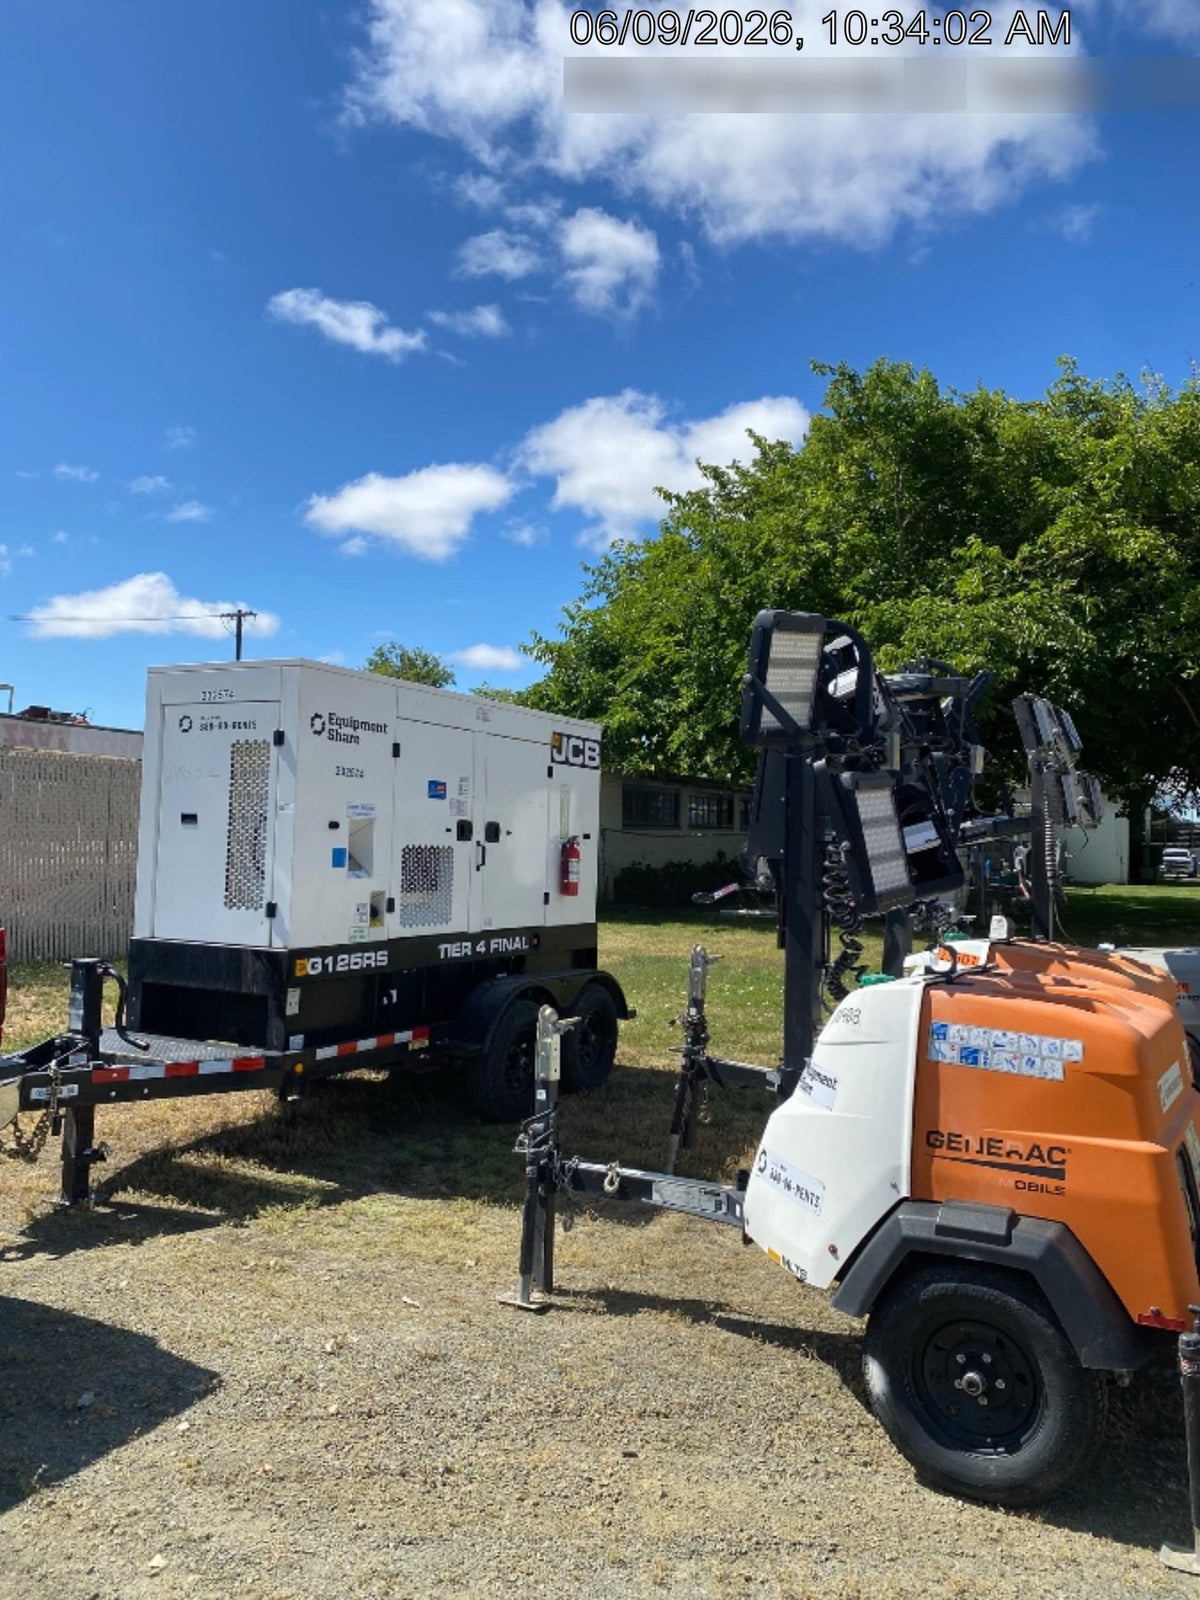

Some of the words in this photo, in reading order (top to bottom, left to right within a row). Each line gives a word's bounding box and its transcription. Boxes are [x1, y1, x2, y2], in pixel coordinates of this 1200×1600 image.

[328, 712, 389, 735] Equipment
[327, 728, 360, 746] Share
[552, 733, 600, 769] JCB
[438, 942, 472, 959] TIER
[476, 940, 486, 955] 4
[490, 936, 530, 953] FINAL
[308, 950, 389, 975] G125RS
